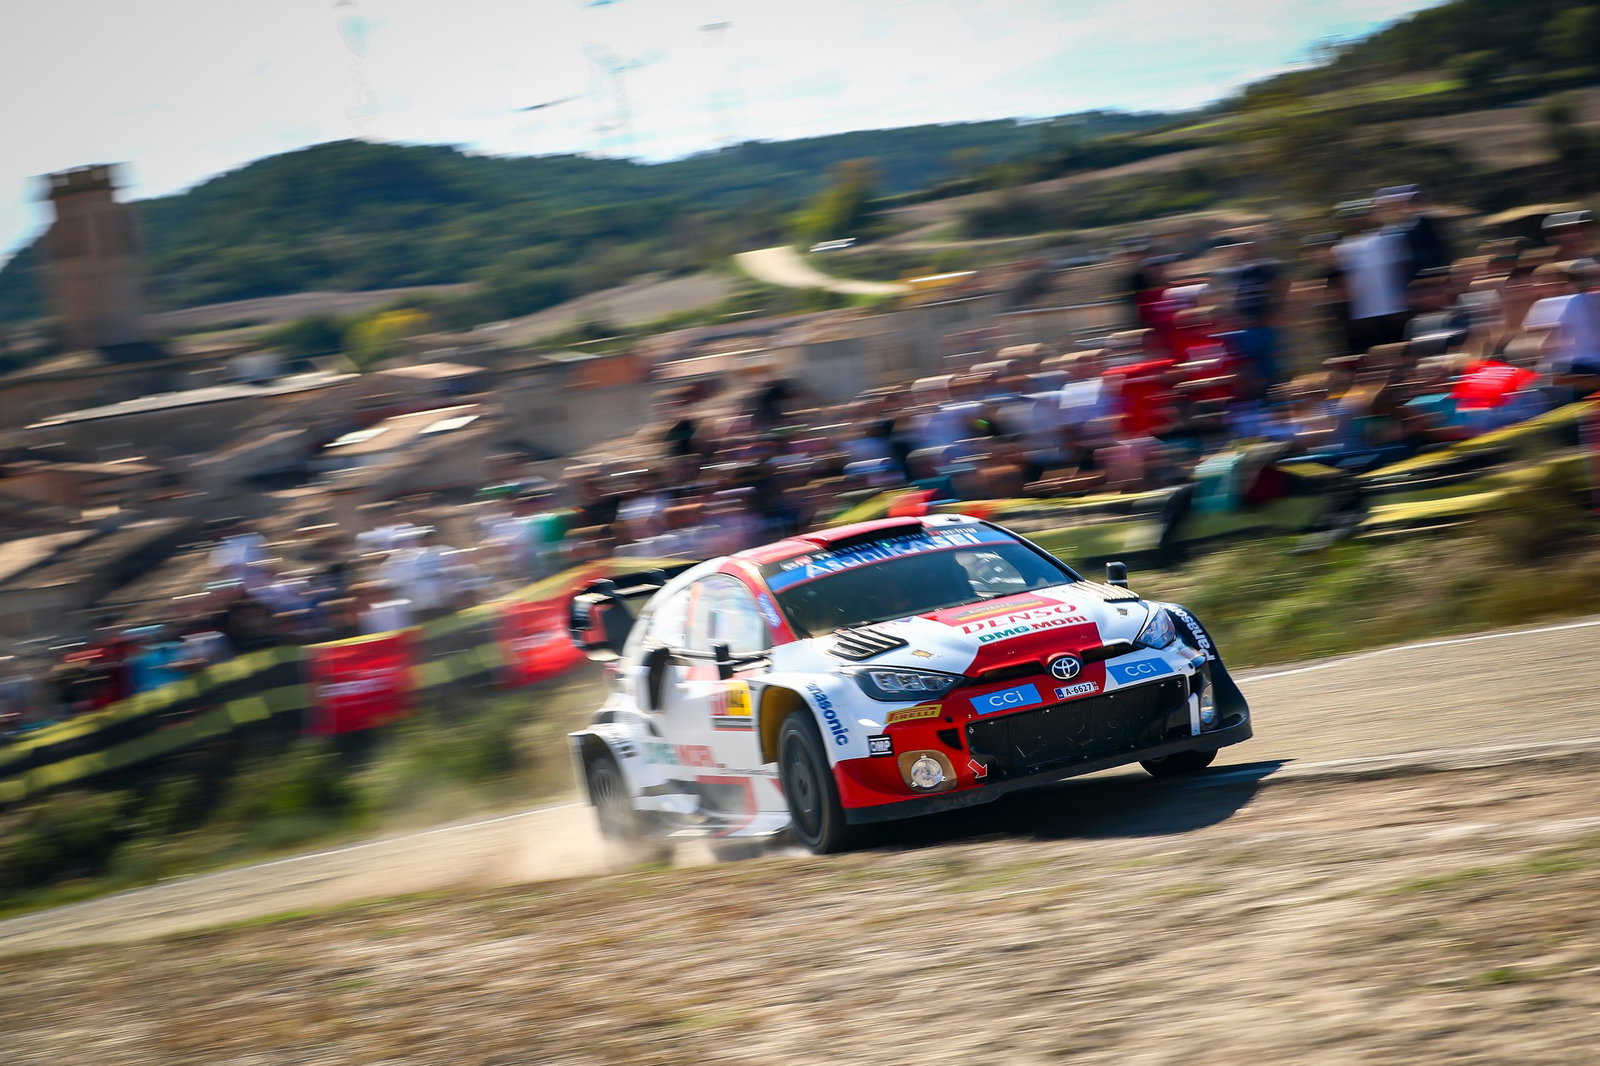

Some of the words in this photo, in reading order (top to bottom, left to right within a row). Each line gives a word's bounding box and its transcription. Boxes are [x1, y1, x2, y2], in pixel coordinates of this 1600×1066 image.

[962, 604, 1077, 634] DENSO
[978, 624, 1030, 643] DMG
[1030, 615, 1088, 631] MORI
[1160, 604, 1216, 661] Panason
[1065, 683, 1092, 696] A-6627
[805, 681, 849, 746] anasonic
[870, 740, 891, 752] OMP
